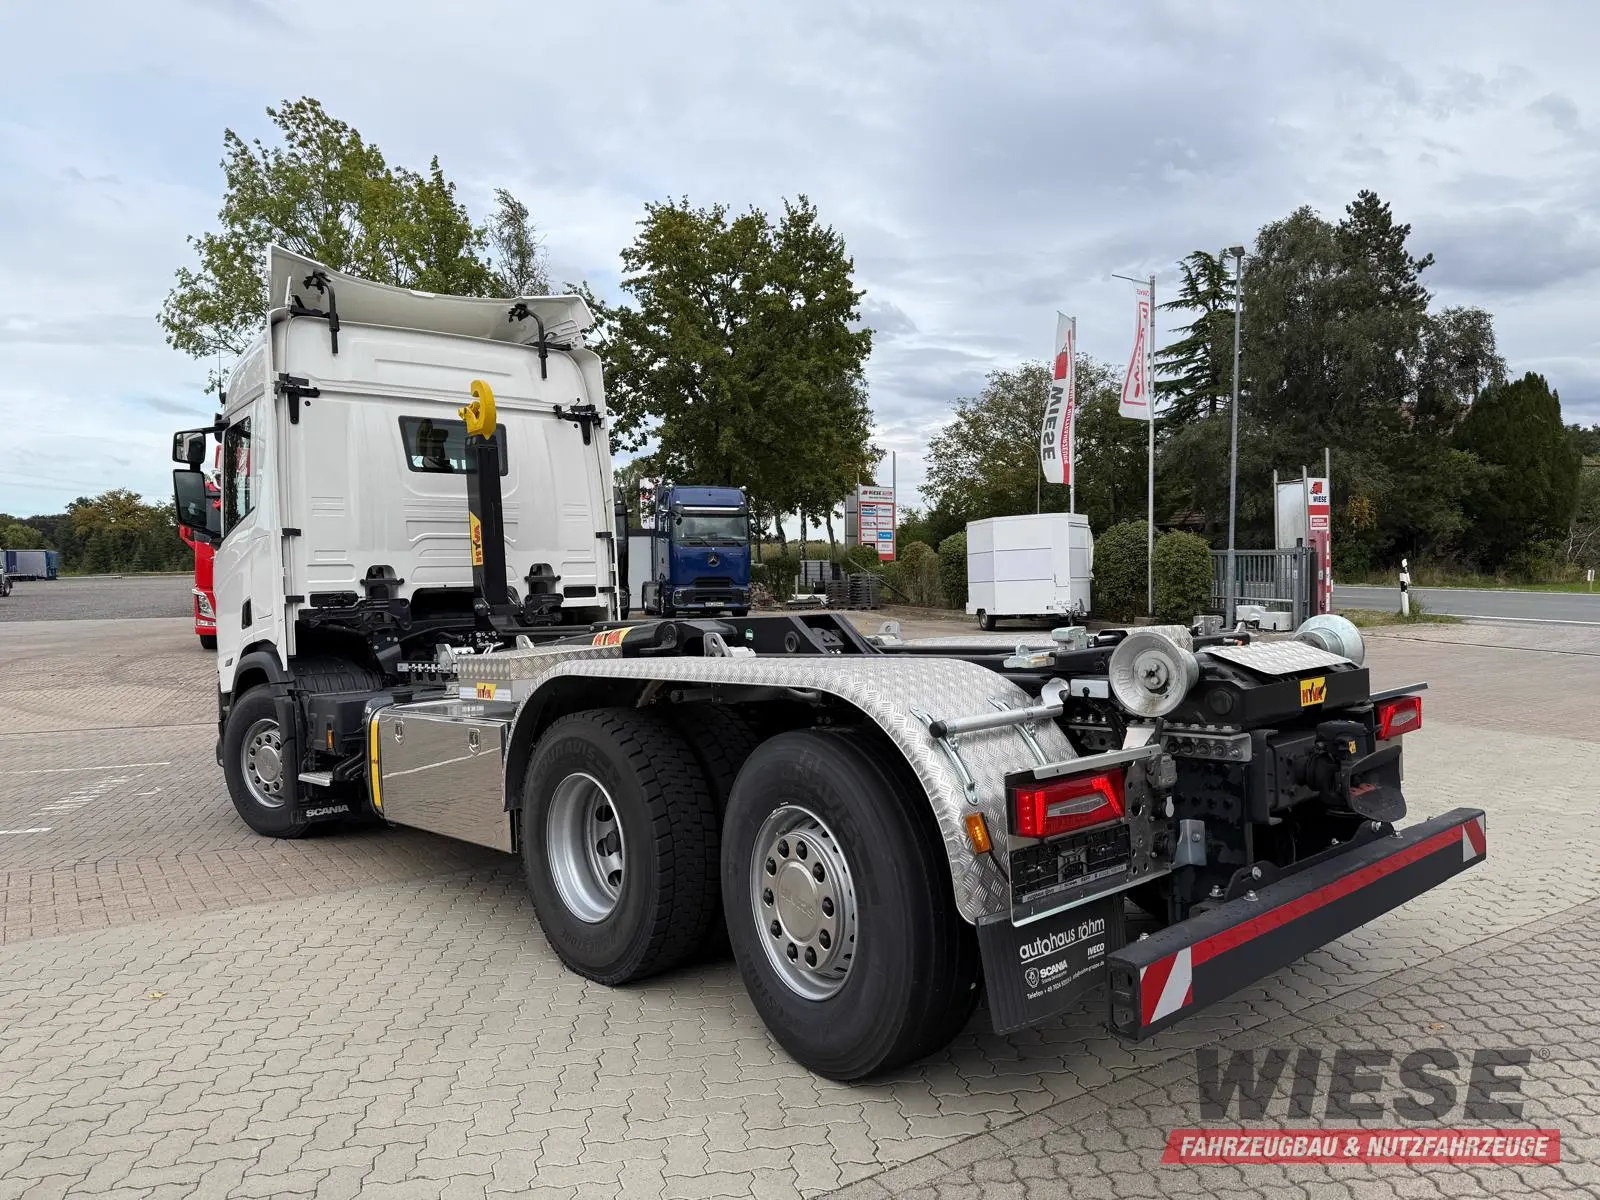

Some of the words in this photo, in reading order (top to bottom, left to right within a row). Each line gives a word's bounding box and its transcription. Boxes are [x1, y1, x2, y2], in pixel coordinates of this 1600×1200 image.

[305, 804, 350, 817] SCANIA
[1020, 928, 1076, 959] autohaus
[1078, 918, 1105, 939] röhm
[1087, 943, 1105, 956] IVECO
[1040, 959, 1068, 978] SCANIA
[1027, 990, 1044, 1000] Telefon
